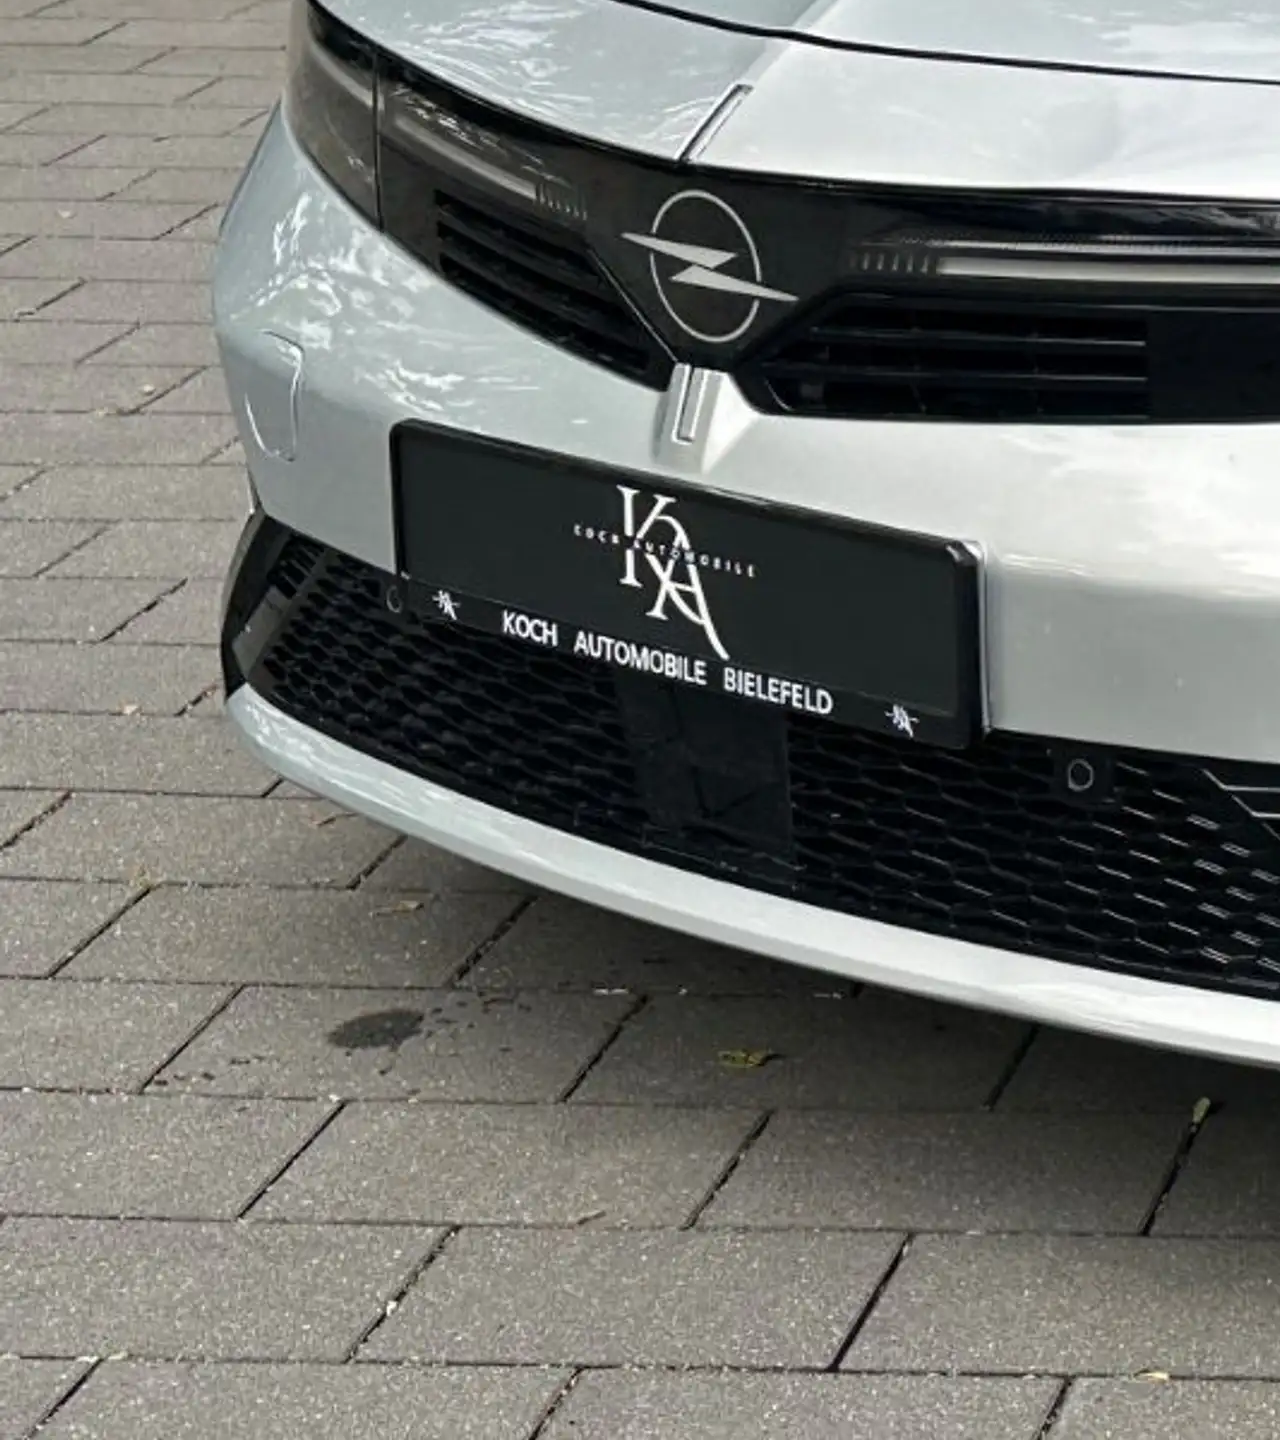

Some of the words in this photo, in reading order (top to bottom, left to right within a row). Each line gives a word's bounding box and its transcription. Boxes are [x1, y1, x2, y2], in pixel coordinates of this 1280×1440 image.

[632, 537, 758, 578] AUTOMOBILE
[502, 609, 558, 646] KOCH
[573, 629, 707, 687] AUTOMOBILE
[723, 666, 834, 716] BIELEFELD
